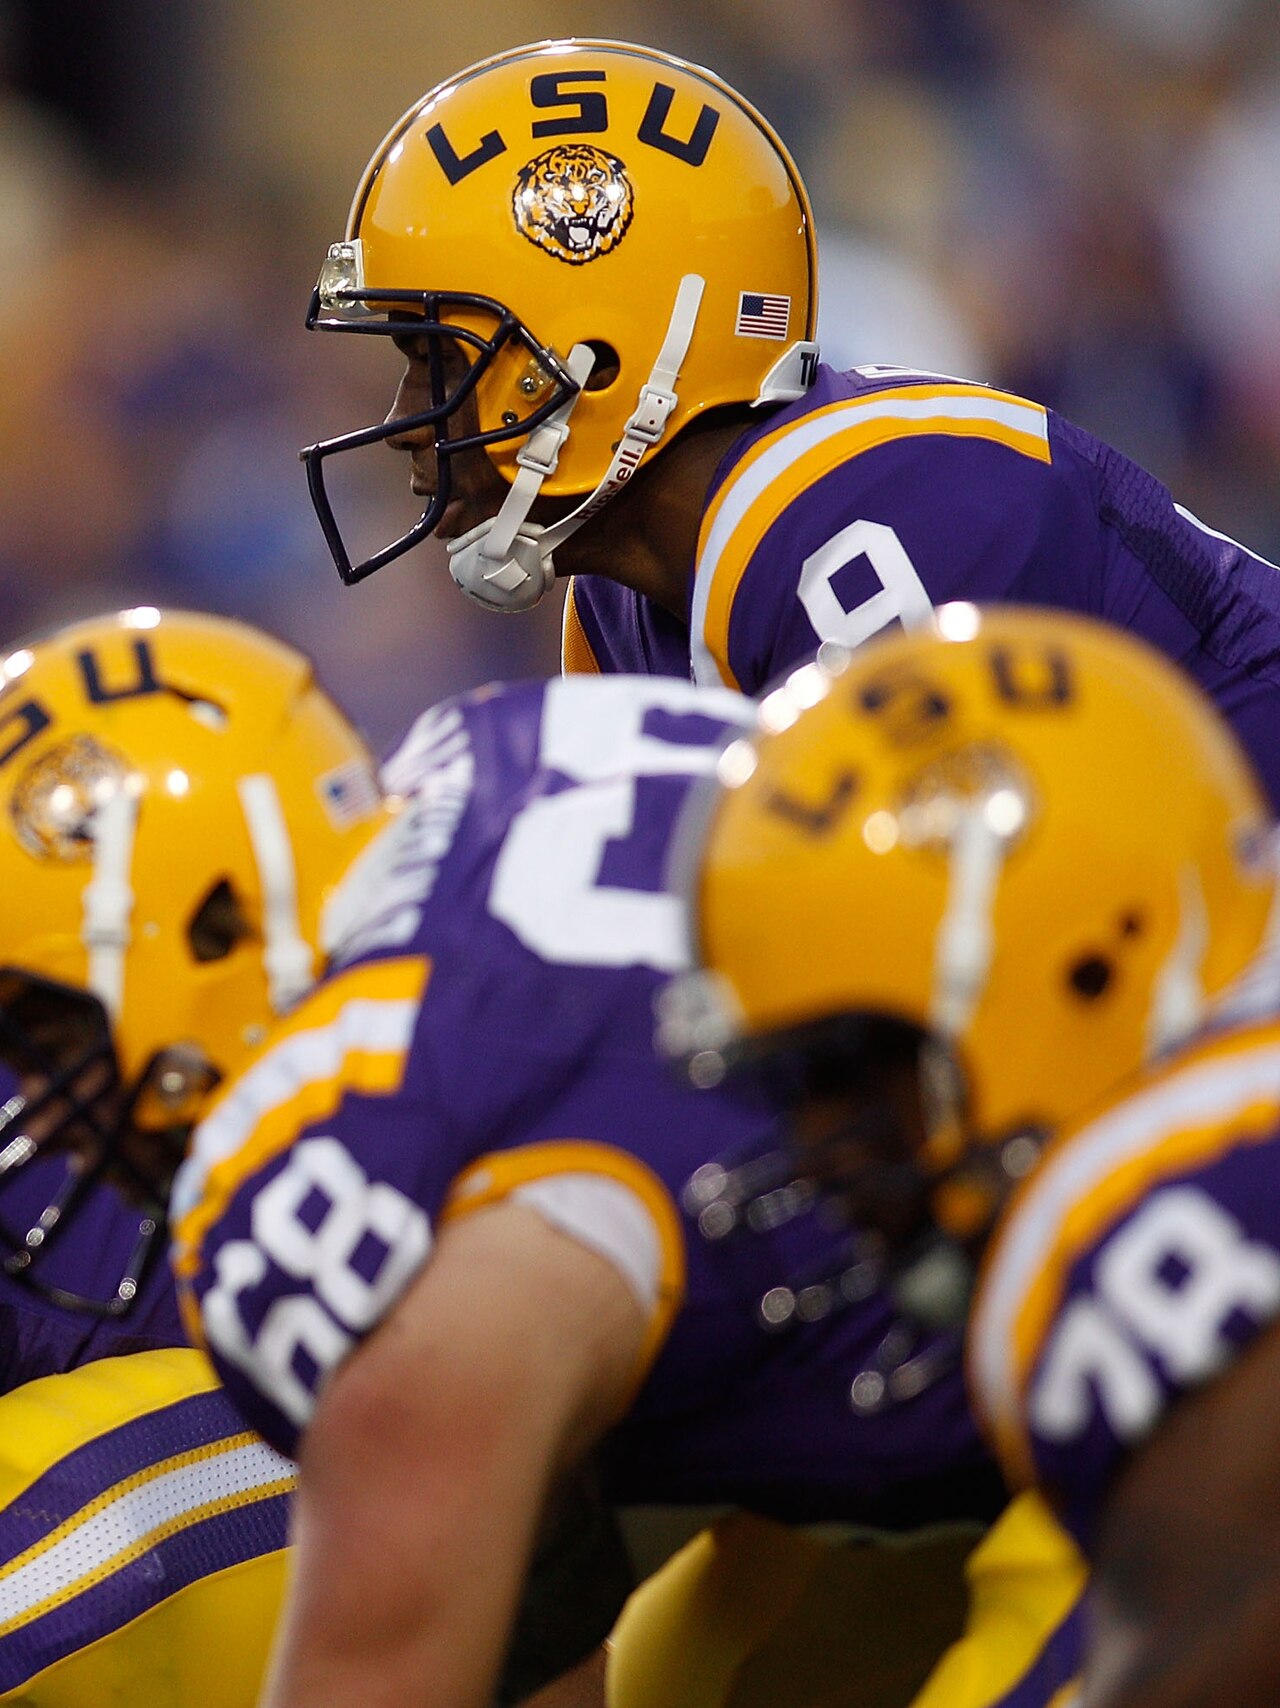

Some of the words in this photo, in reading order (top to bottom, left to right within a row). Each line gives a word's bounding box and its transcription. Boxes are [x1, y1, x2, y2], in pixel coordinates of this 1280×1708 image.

[425, 71, 720, 185] LSU
[797, 519, 938, 650] 9
[201, 1136, 433, 1430] 68
[1029, 1184, 1280, 1444] 78
